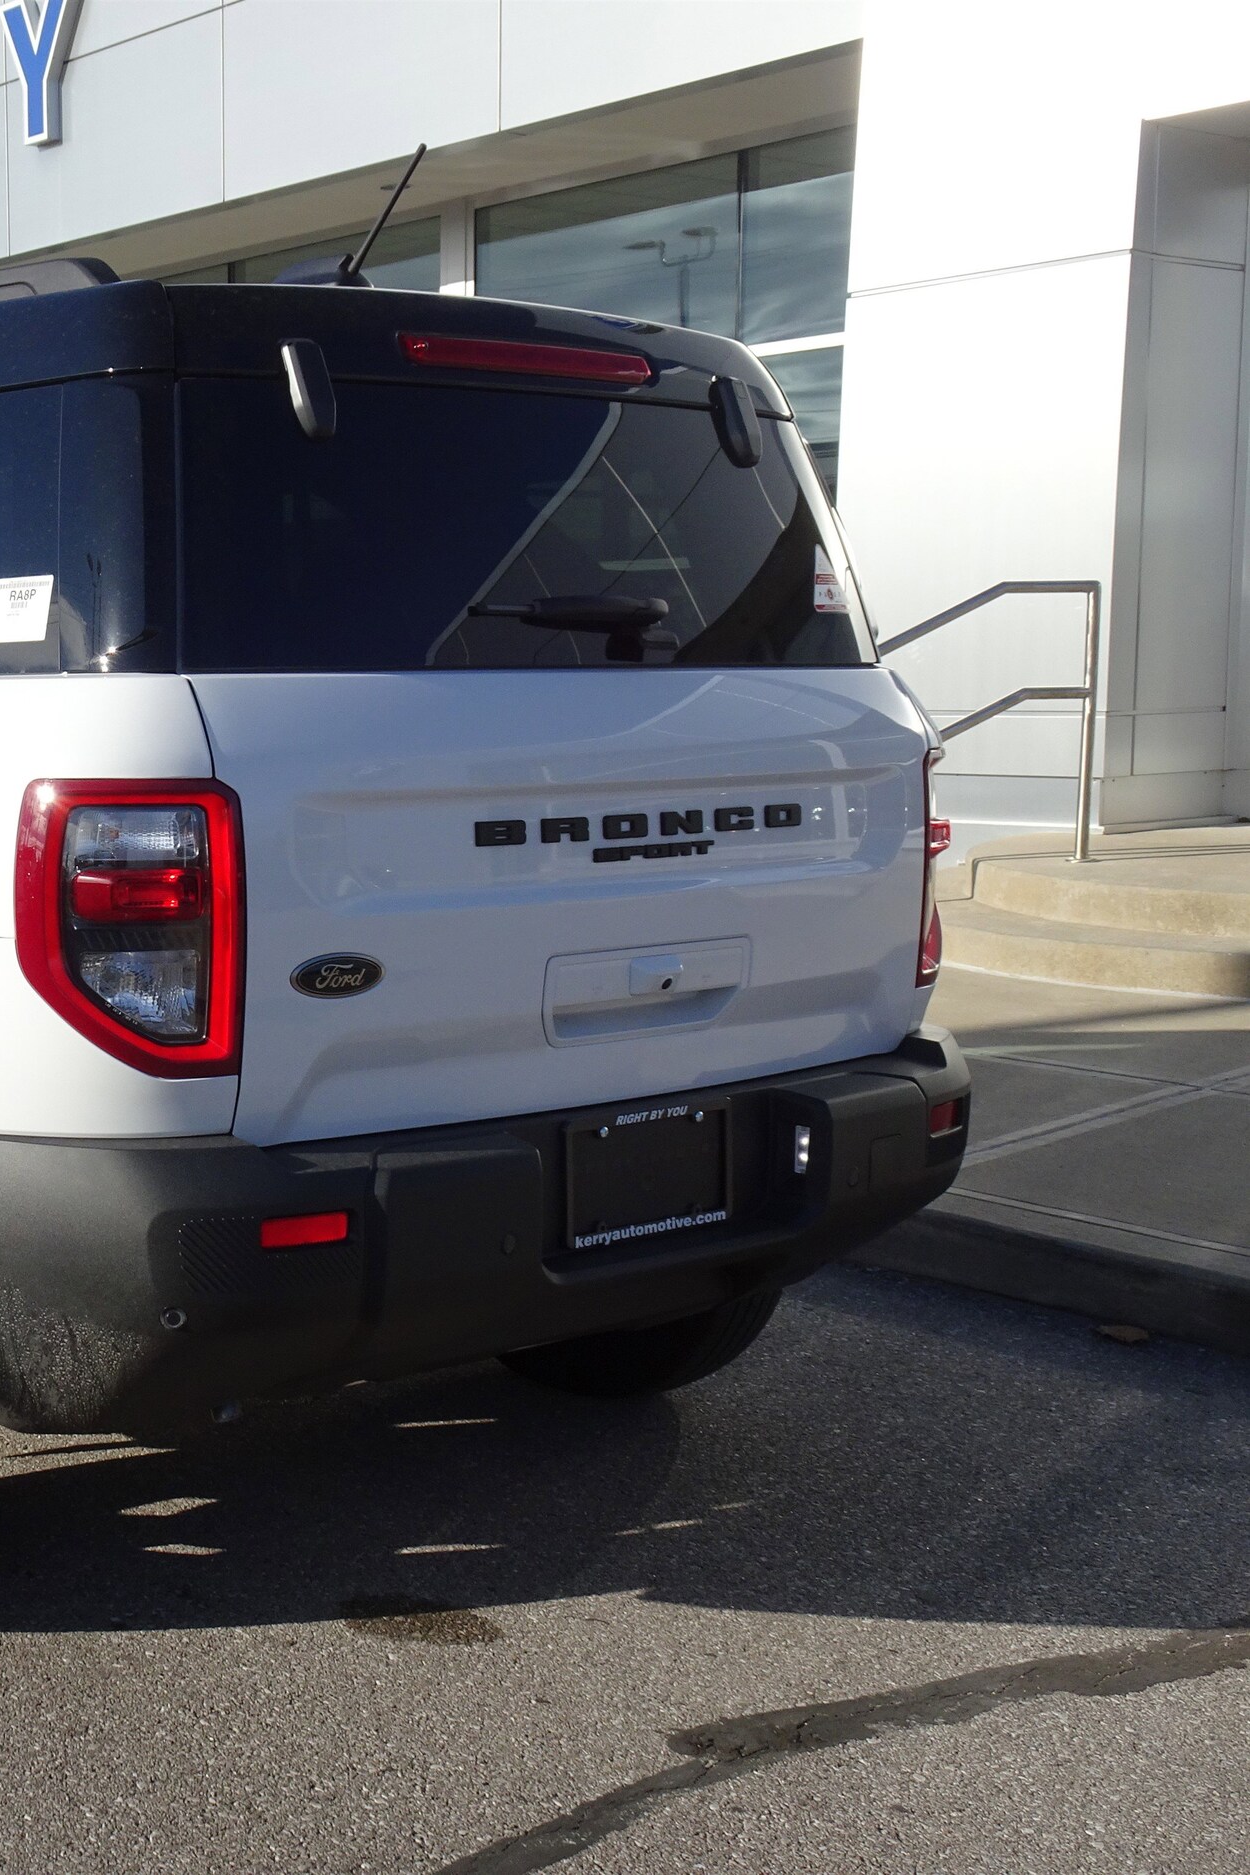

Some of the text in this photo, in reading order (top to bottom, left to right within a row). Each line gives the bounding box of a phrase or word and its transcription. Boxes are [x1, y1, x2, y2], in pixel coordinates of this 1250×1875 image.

[9, 588, 37, 601] RA8P
[474, 803, 802, 847] BRONCO
[592, 840, 715, 863] SPORT
[315, 963, 366, 989] Ford
[615, 1105, 689, 1126] RIGHT BY YOU
[574, 1210, 727, 1249] kerryautomotive.com
